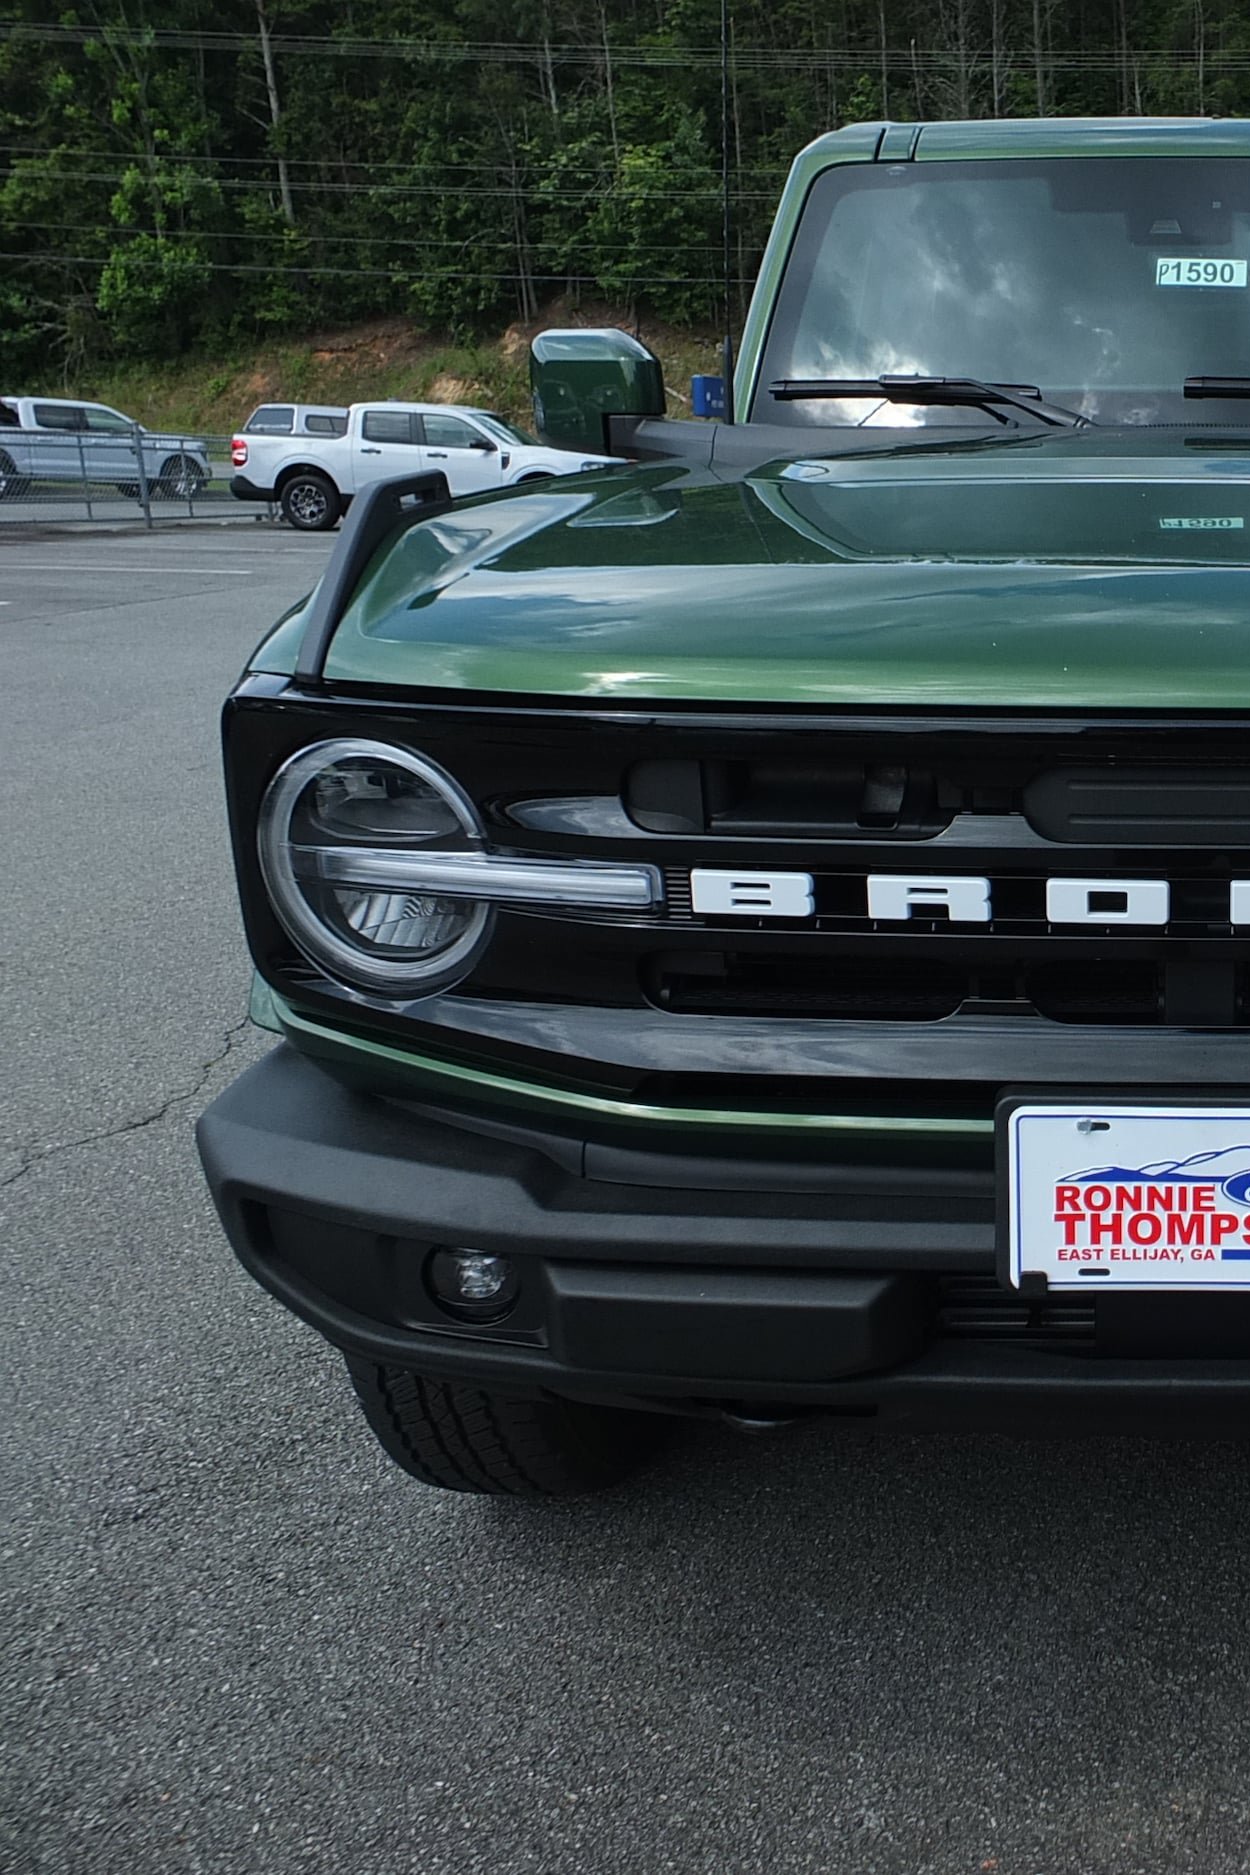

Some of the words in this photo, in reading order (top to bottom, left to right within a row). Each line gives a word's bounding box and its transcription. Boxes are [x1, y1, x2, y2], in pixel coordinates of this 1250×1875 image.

[1055, 1185, 1216, 1212] RONNIE
[1057, 1248, 1103, 1261] EAST
[1109, 1248, 1184, 1263] ELLIJAY,
[1190, 1249, 1216, 1262] GA
